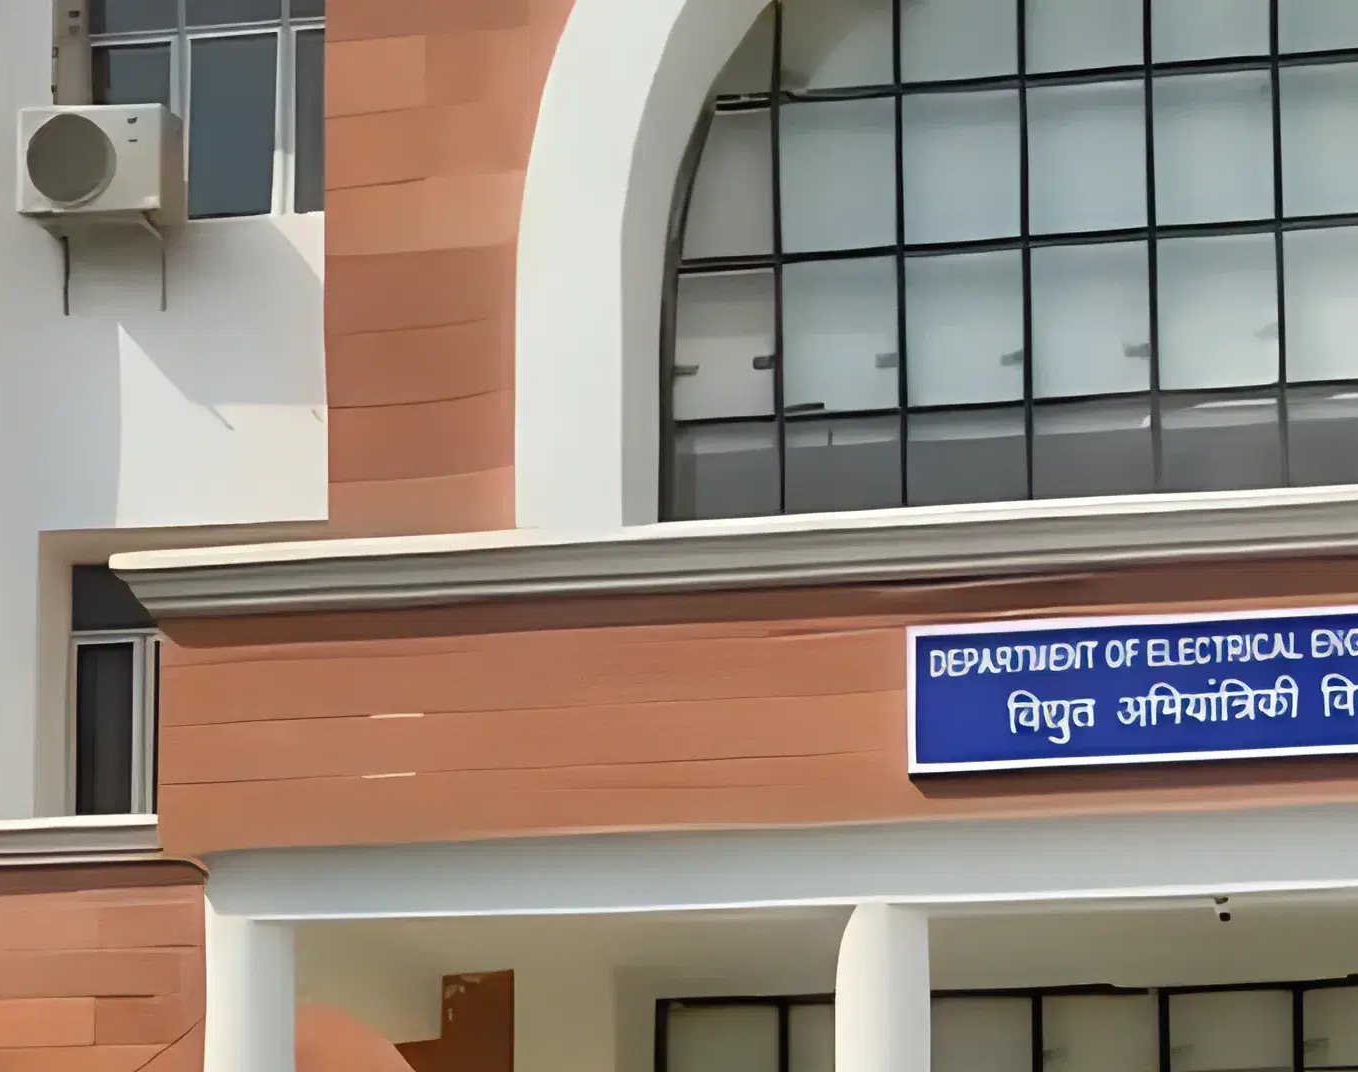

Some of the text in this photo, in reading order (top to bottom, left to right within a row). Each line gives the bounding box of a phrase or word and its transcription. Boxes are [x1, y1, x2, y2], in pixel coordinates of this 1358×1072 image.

[929, 640, 1099, 678] DEPARTMENT
[1104, 638, 1140, 669] OF
[1146, 631, 1304, 667] ELECTRICAL
